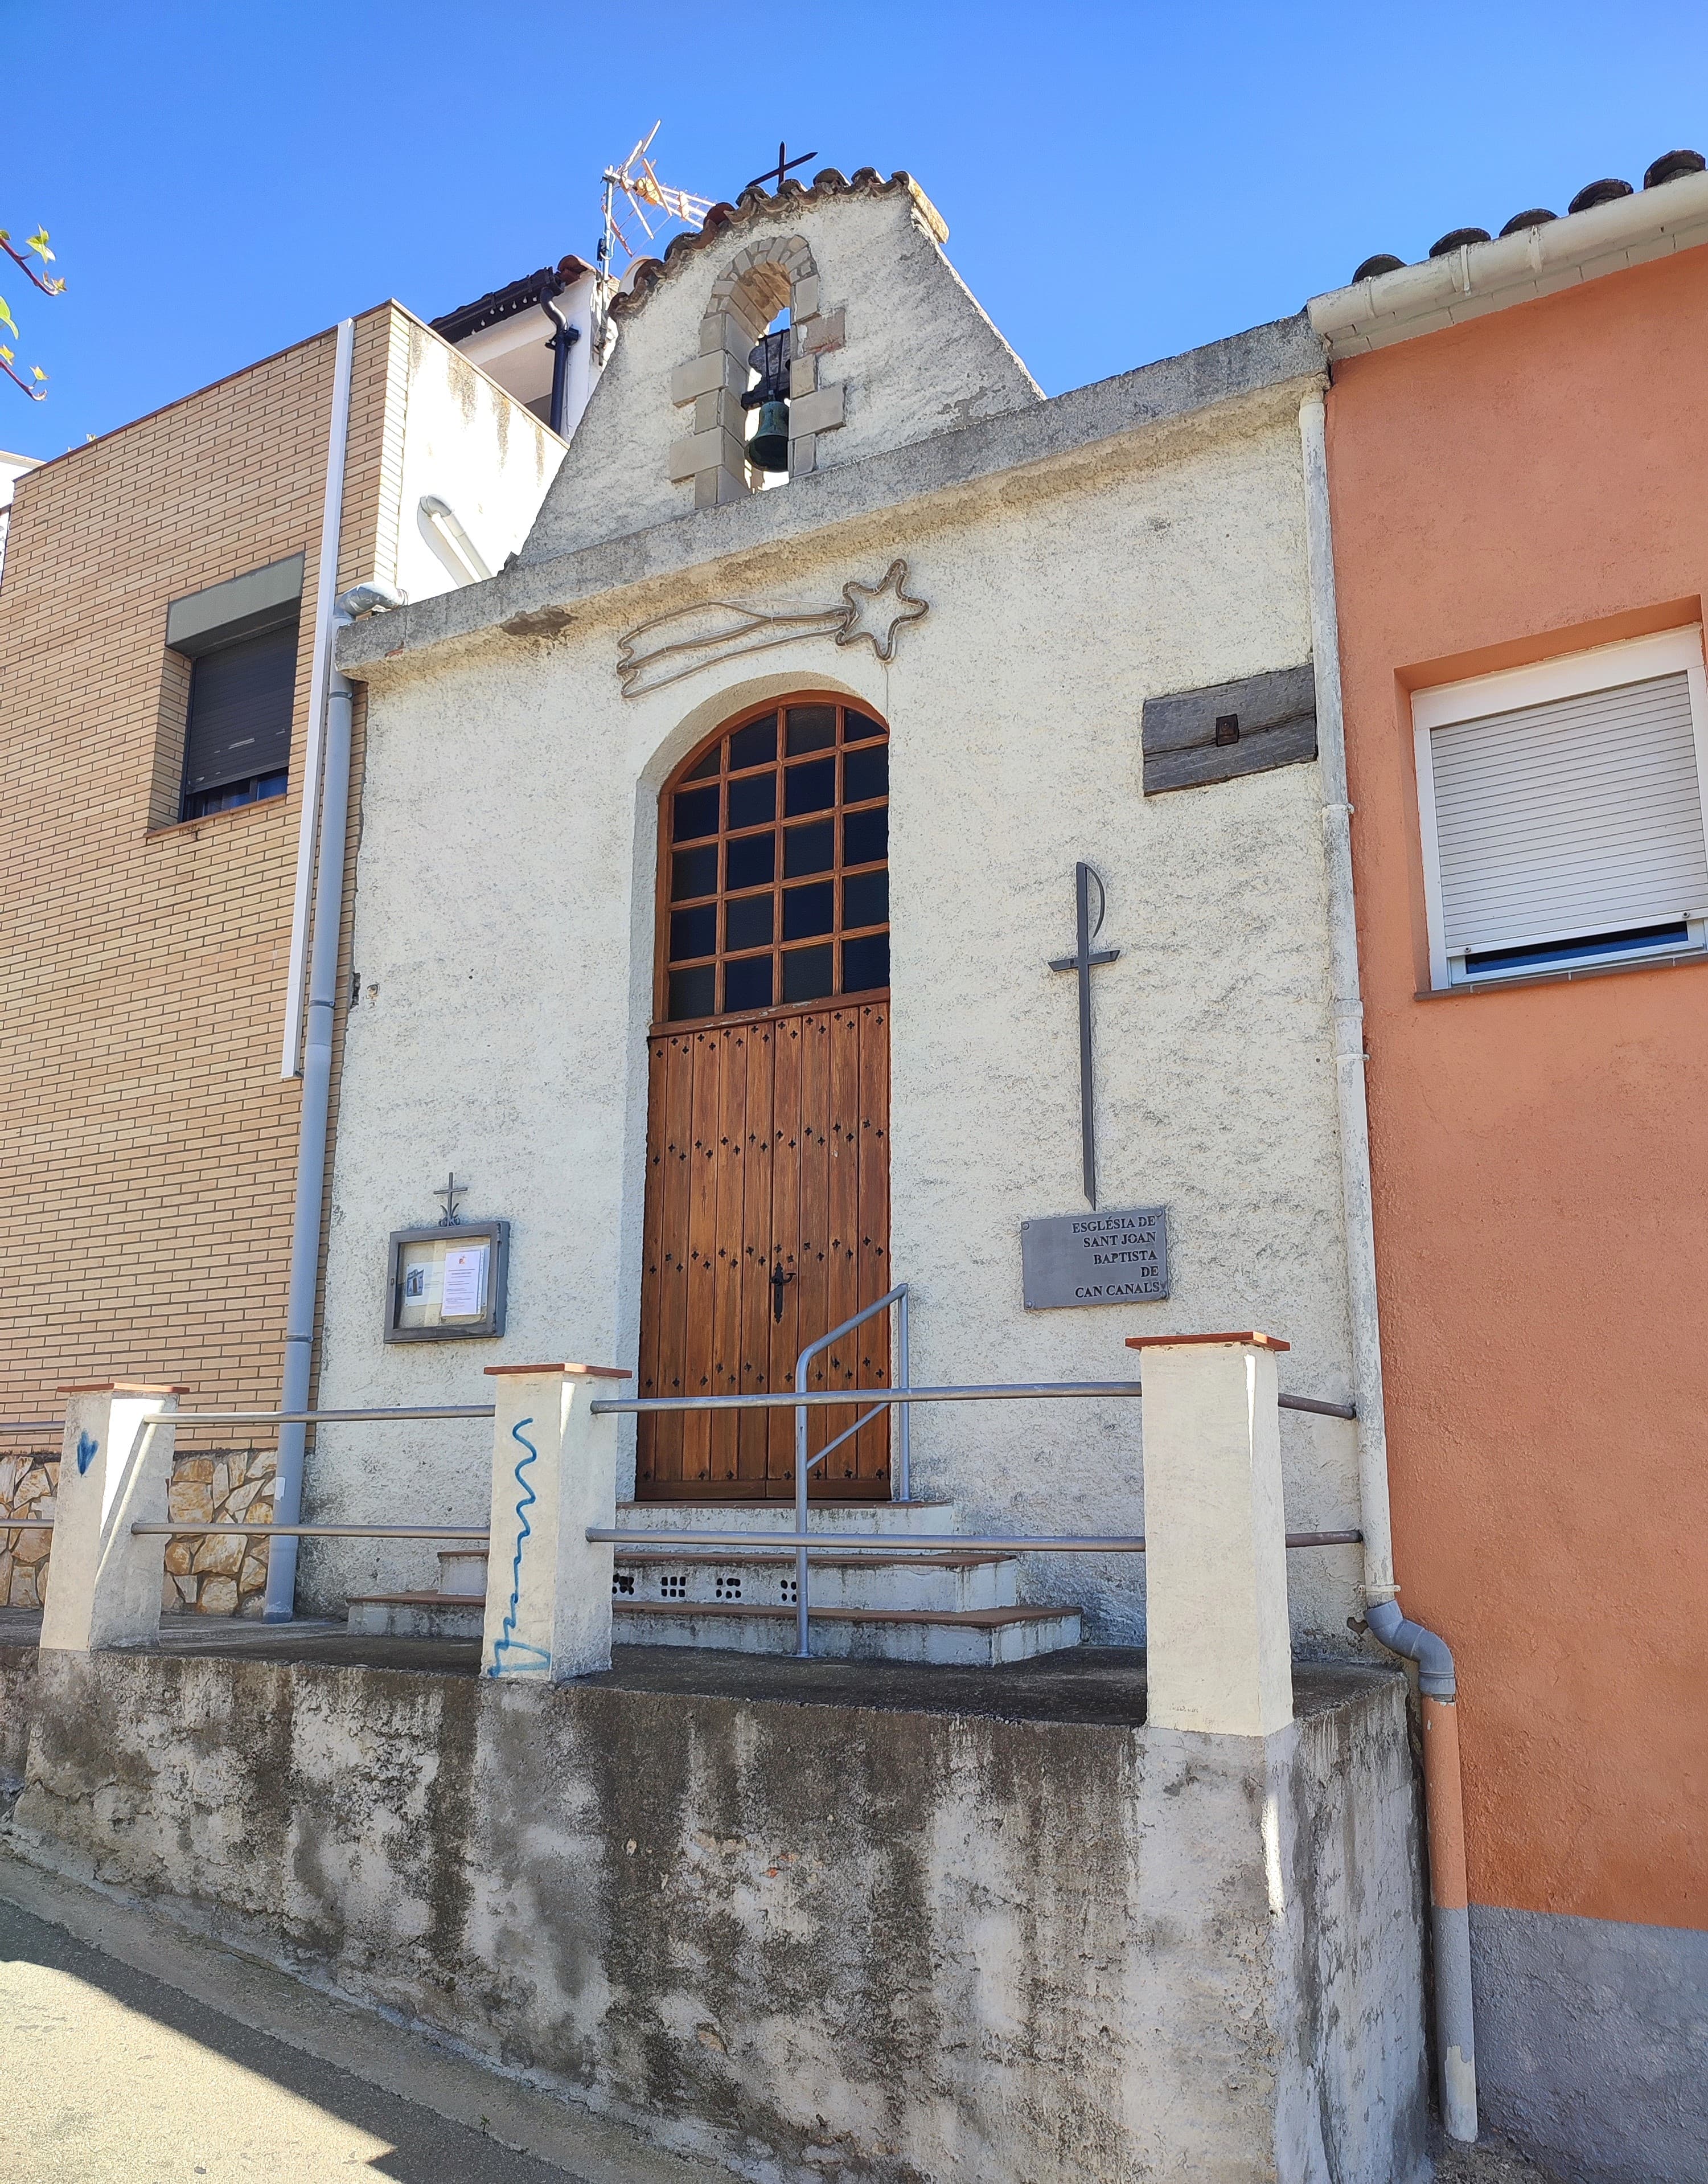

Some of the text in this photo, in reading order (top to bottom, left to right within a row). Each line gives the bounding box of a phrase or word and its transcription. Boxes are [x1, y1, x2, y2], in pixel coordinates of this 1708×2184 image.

[1072, 1216, 1156, 1233] ESGLÉSIA DE
[1083, 1232, 1156, 1248] SANT JOAN
[1094, 1250, 1158, 1265] BAPTISTA
[1140, 1266, 1159, 1277] DE
[1075, 1282, 1160, 1298] CAN CANALS
